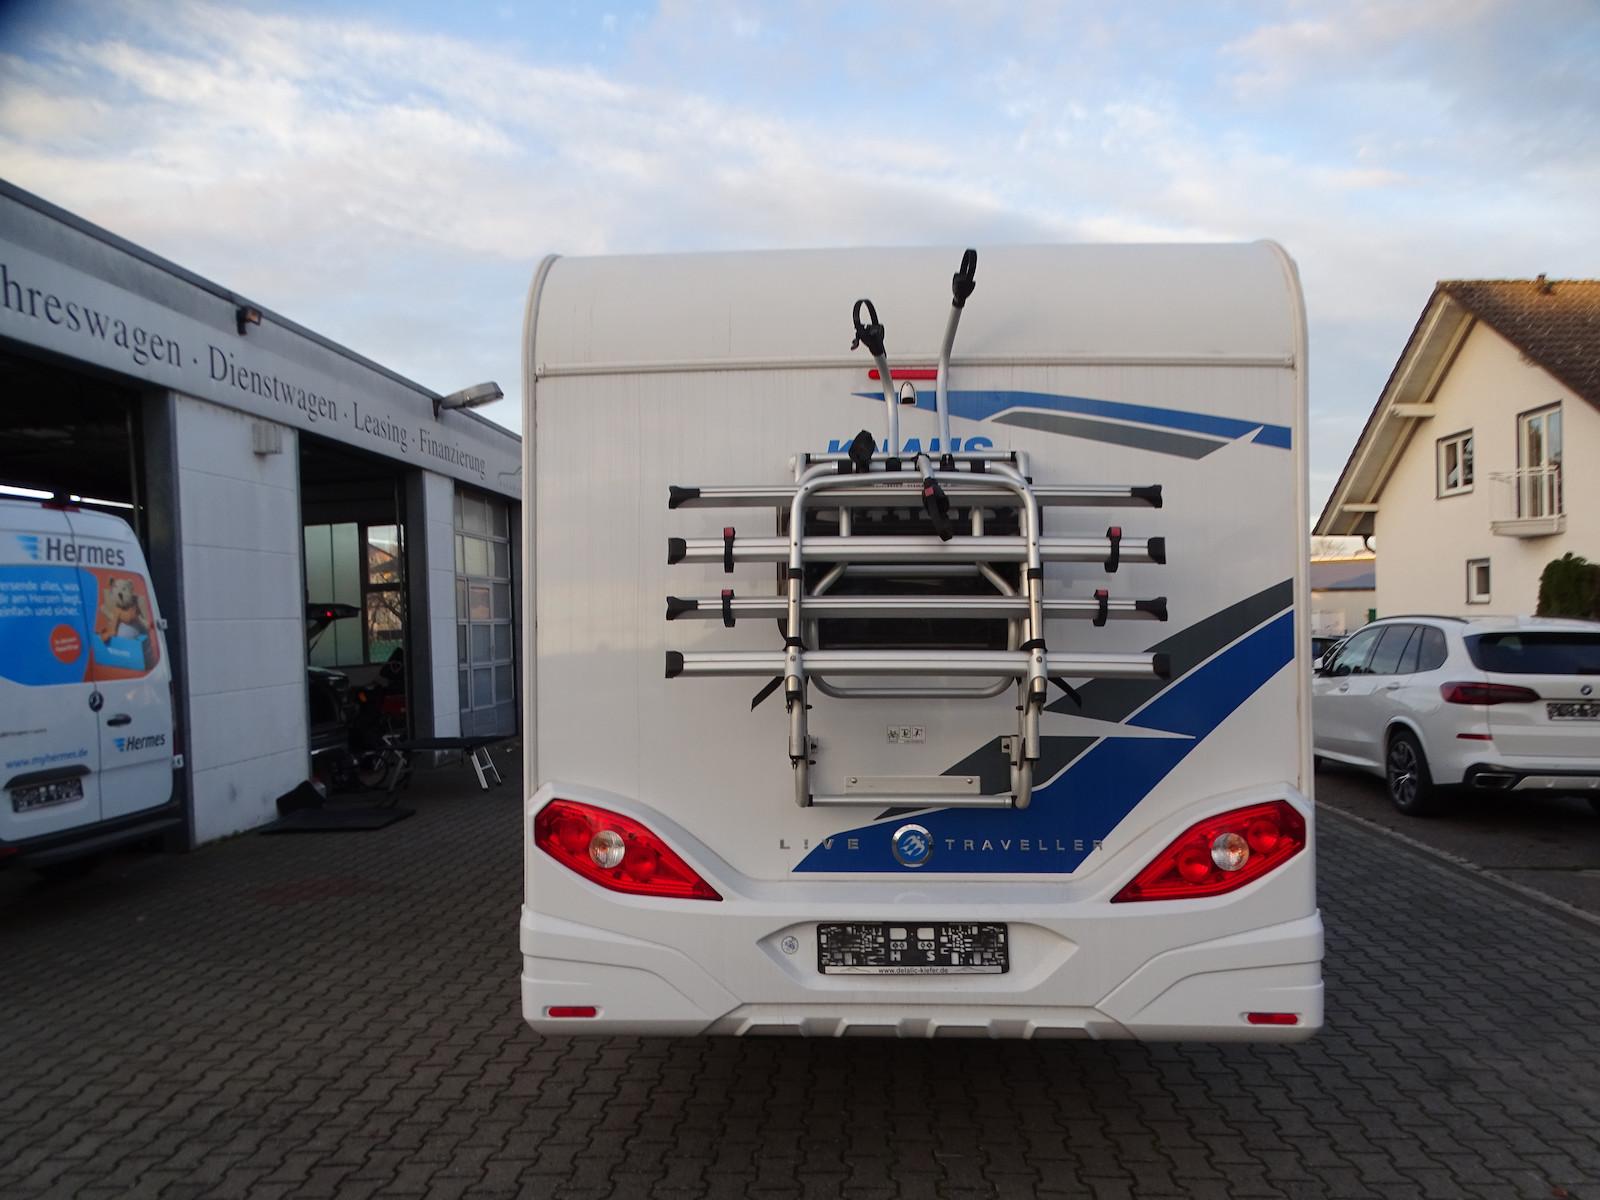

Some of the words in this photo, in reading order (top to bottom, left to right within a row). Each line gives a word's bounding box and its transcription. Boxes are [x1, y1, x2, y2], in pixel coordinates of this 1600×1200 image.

[0, 264, 182, 367] hreswagen
[208, 344, 337, 422] Dienstwagen
[353, 402, 408, 453] Leasing
[419, 429, 486, 480] Finanzierung
[46, 537, 126, 567] Hermes
[126, 733, 166, 752] Hermes
[779, 837, 861, 851] LIVE
[945, 838, 1104, 851] TRAVELLER
